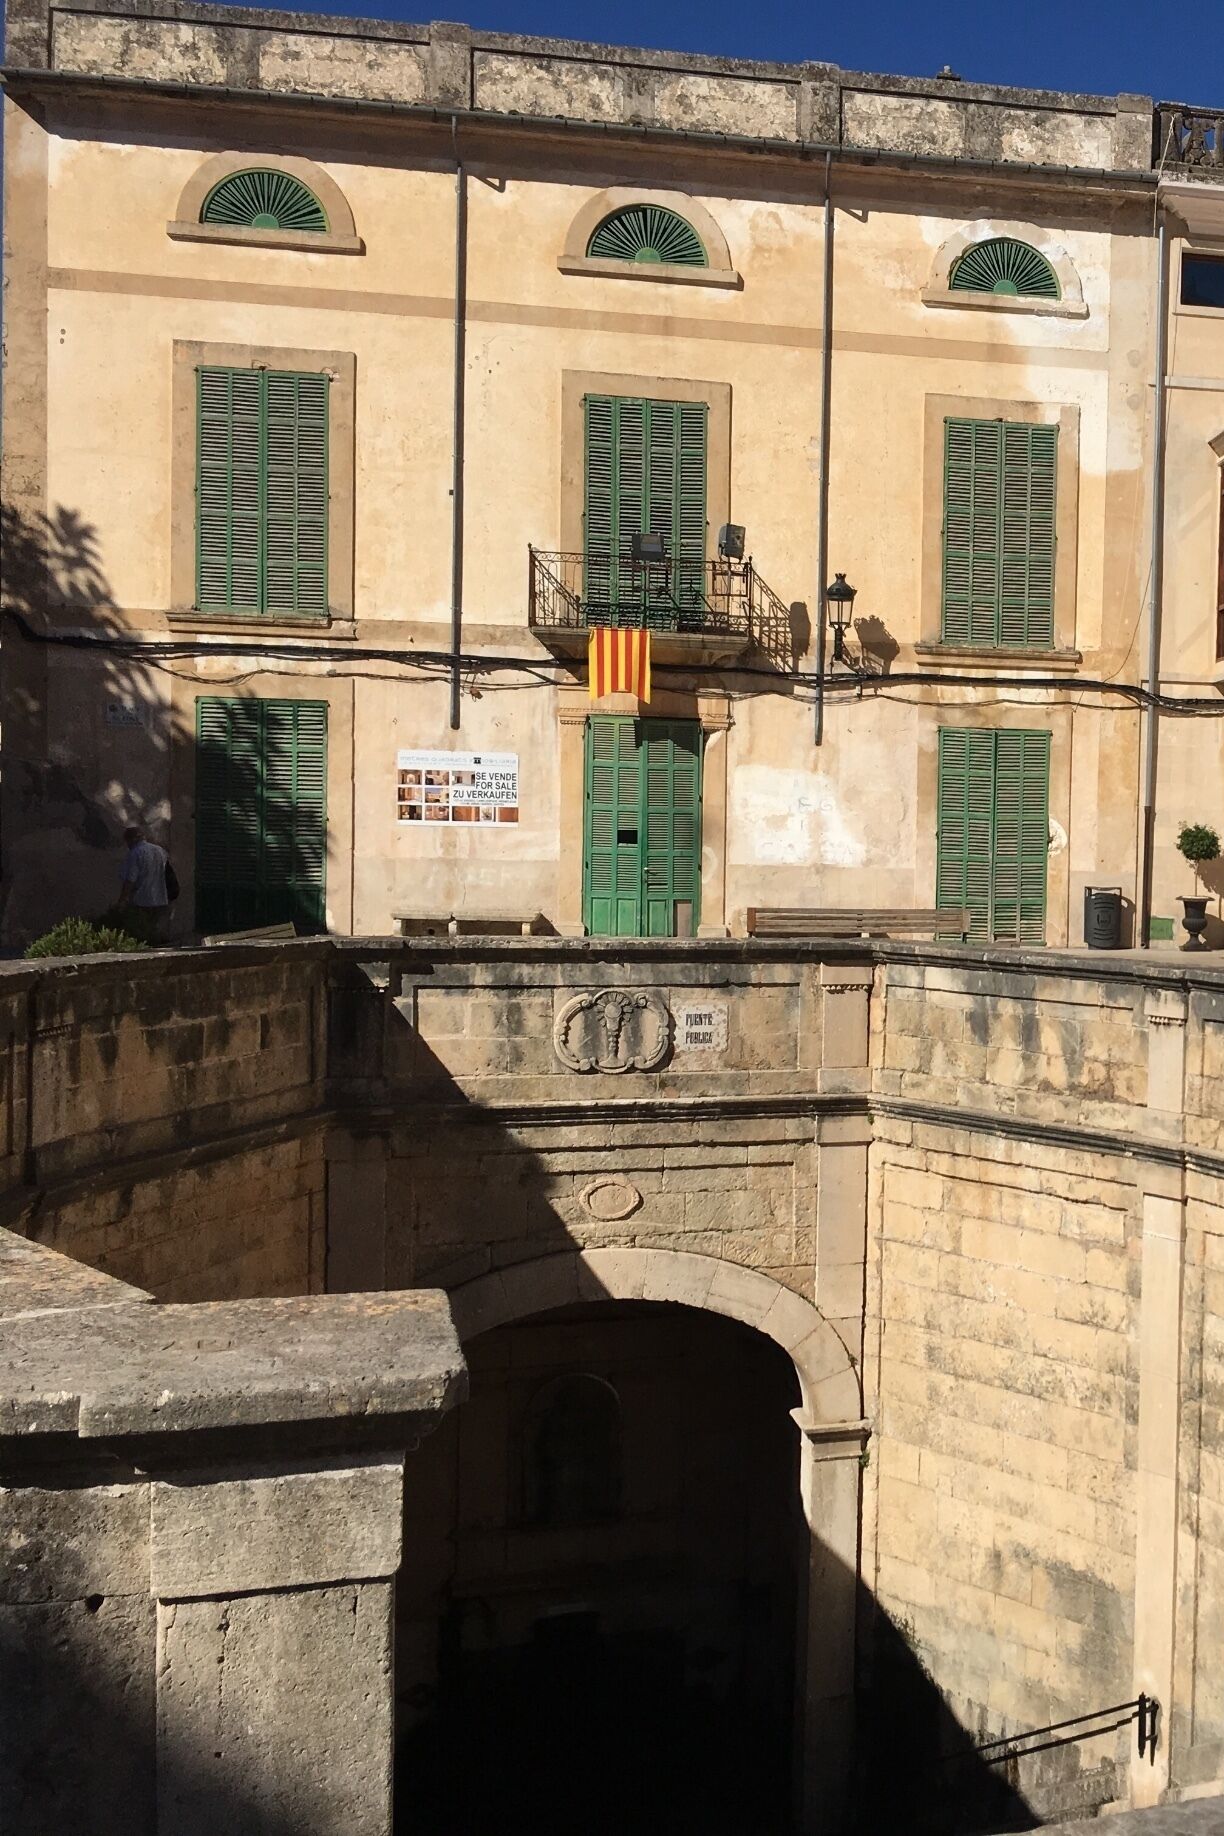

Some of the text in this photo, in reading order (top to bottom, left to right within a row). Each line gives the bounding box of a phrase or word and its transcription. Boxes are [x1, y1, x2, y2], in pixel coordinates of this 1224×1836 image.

[476, 772, 517, 782] SE VENDE
[476, 781, 517, 791] FOR SALE
[453, 790, 517, 800] ZU VERKAUFEN
